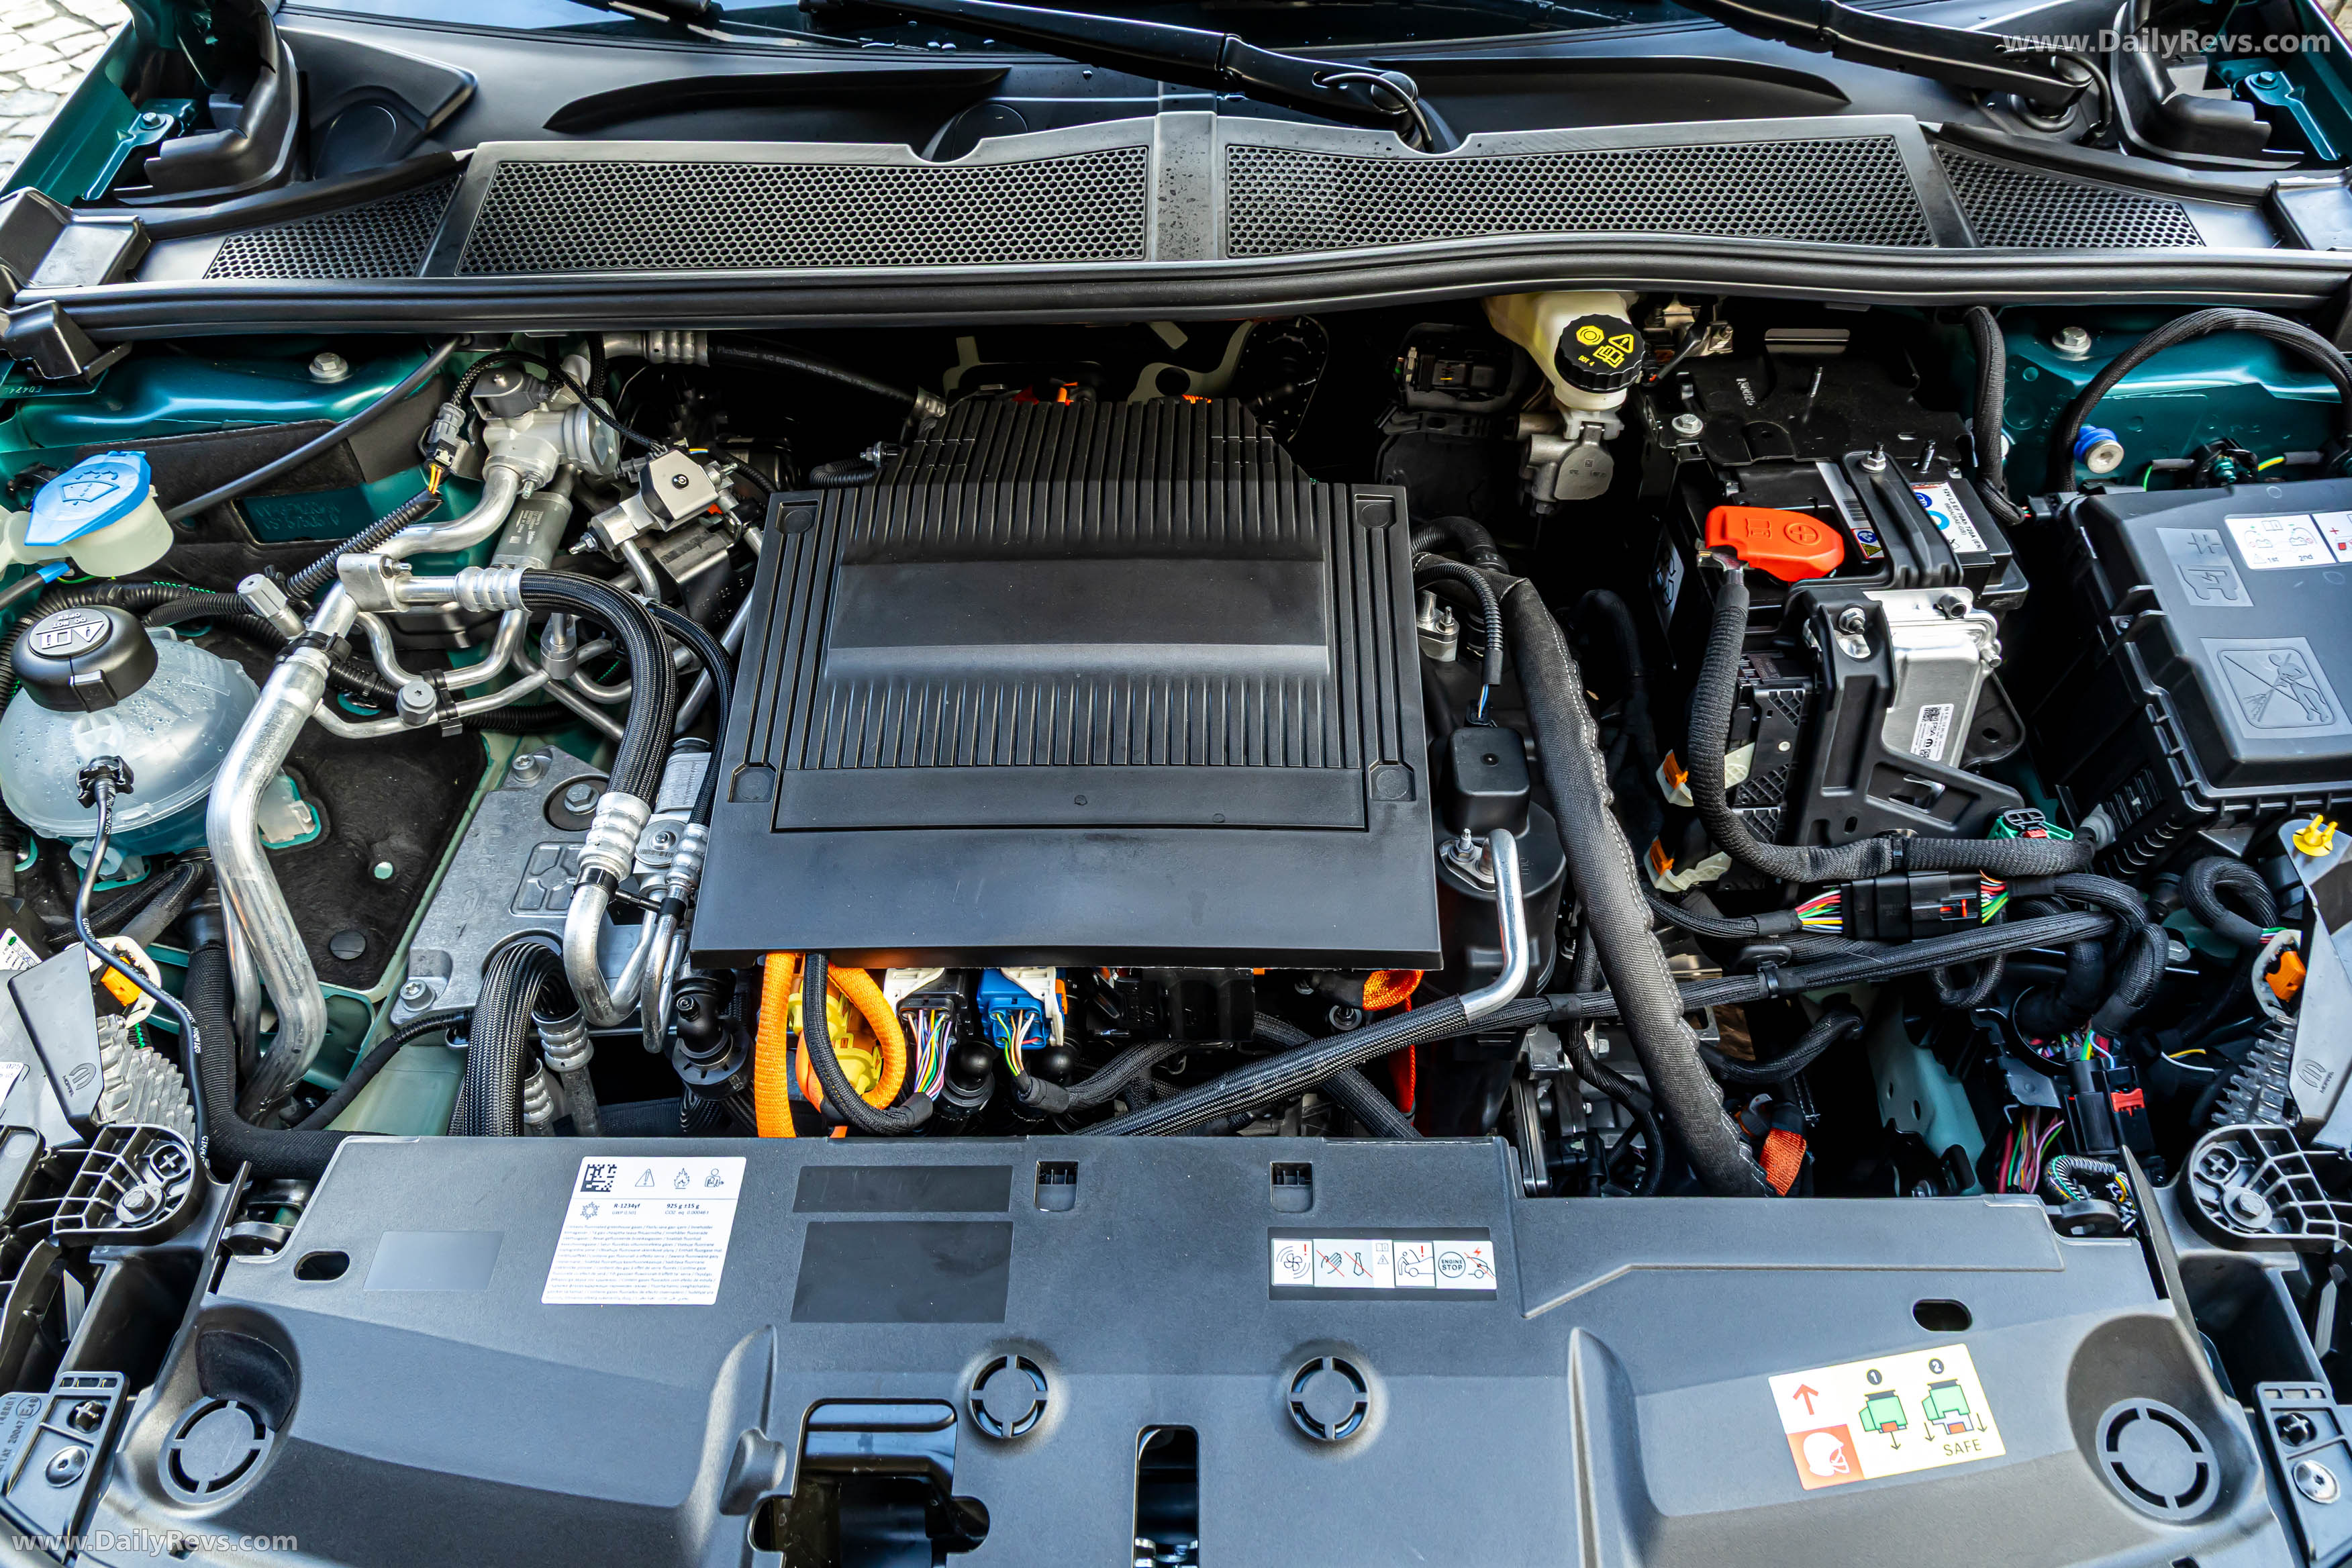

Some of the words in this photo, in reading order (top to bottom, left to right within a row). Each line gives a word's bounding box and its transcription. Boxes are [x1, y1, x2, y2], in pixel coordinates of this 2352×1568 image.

[1578, 355, 1590, 363] DOT
[775, 356, 806, 369] SUCTION
[807, 364, 827, 375] HOSE
[1965, 526, 1976, 538] 720A
[58, 611, 81, 622] OPEN
[52, 621, 70, 629] NOT
[1870, 1371, 1878, 1383] 1
[1932, 1361, 1942, 1373] 2
[1943, 1439, 1982, 1456] SAFE
